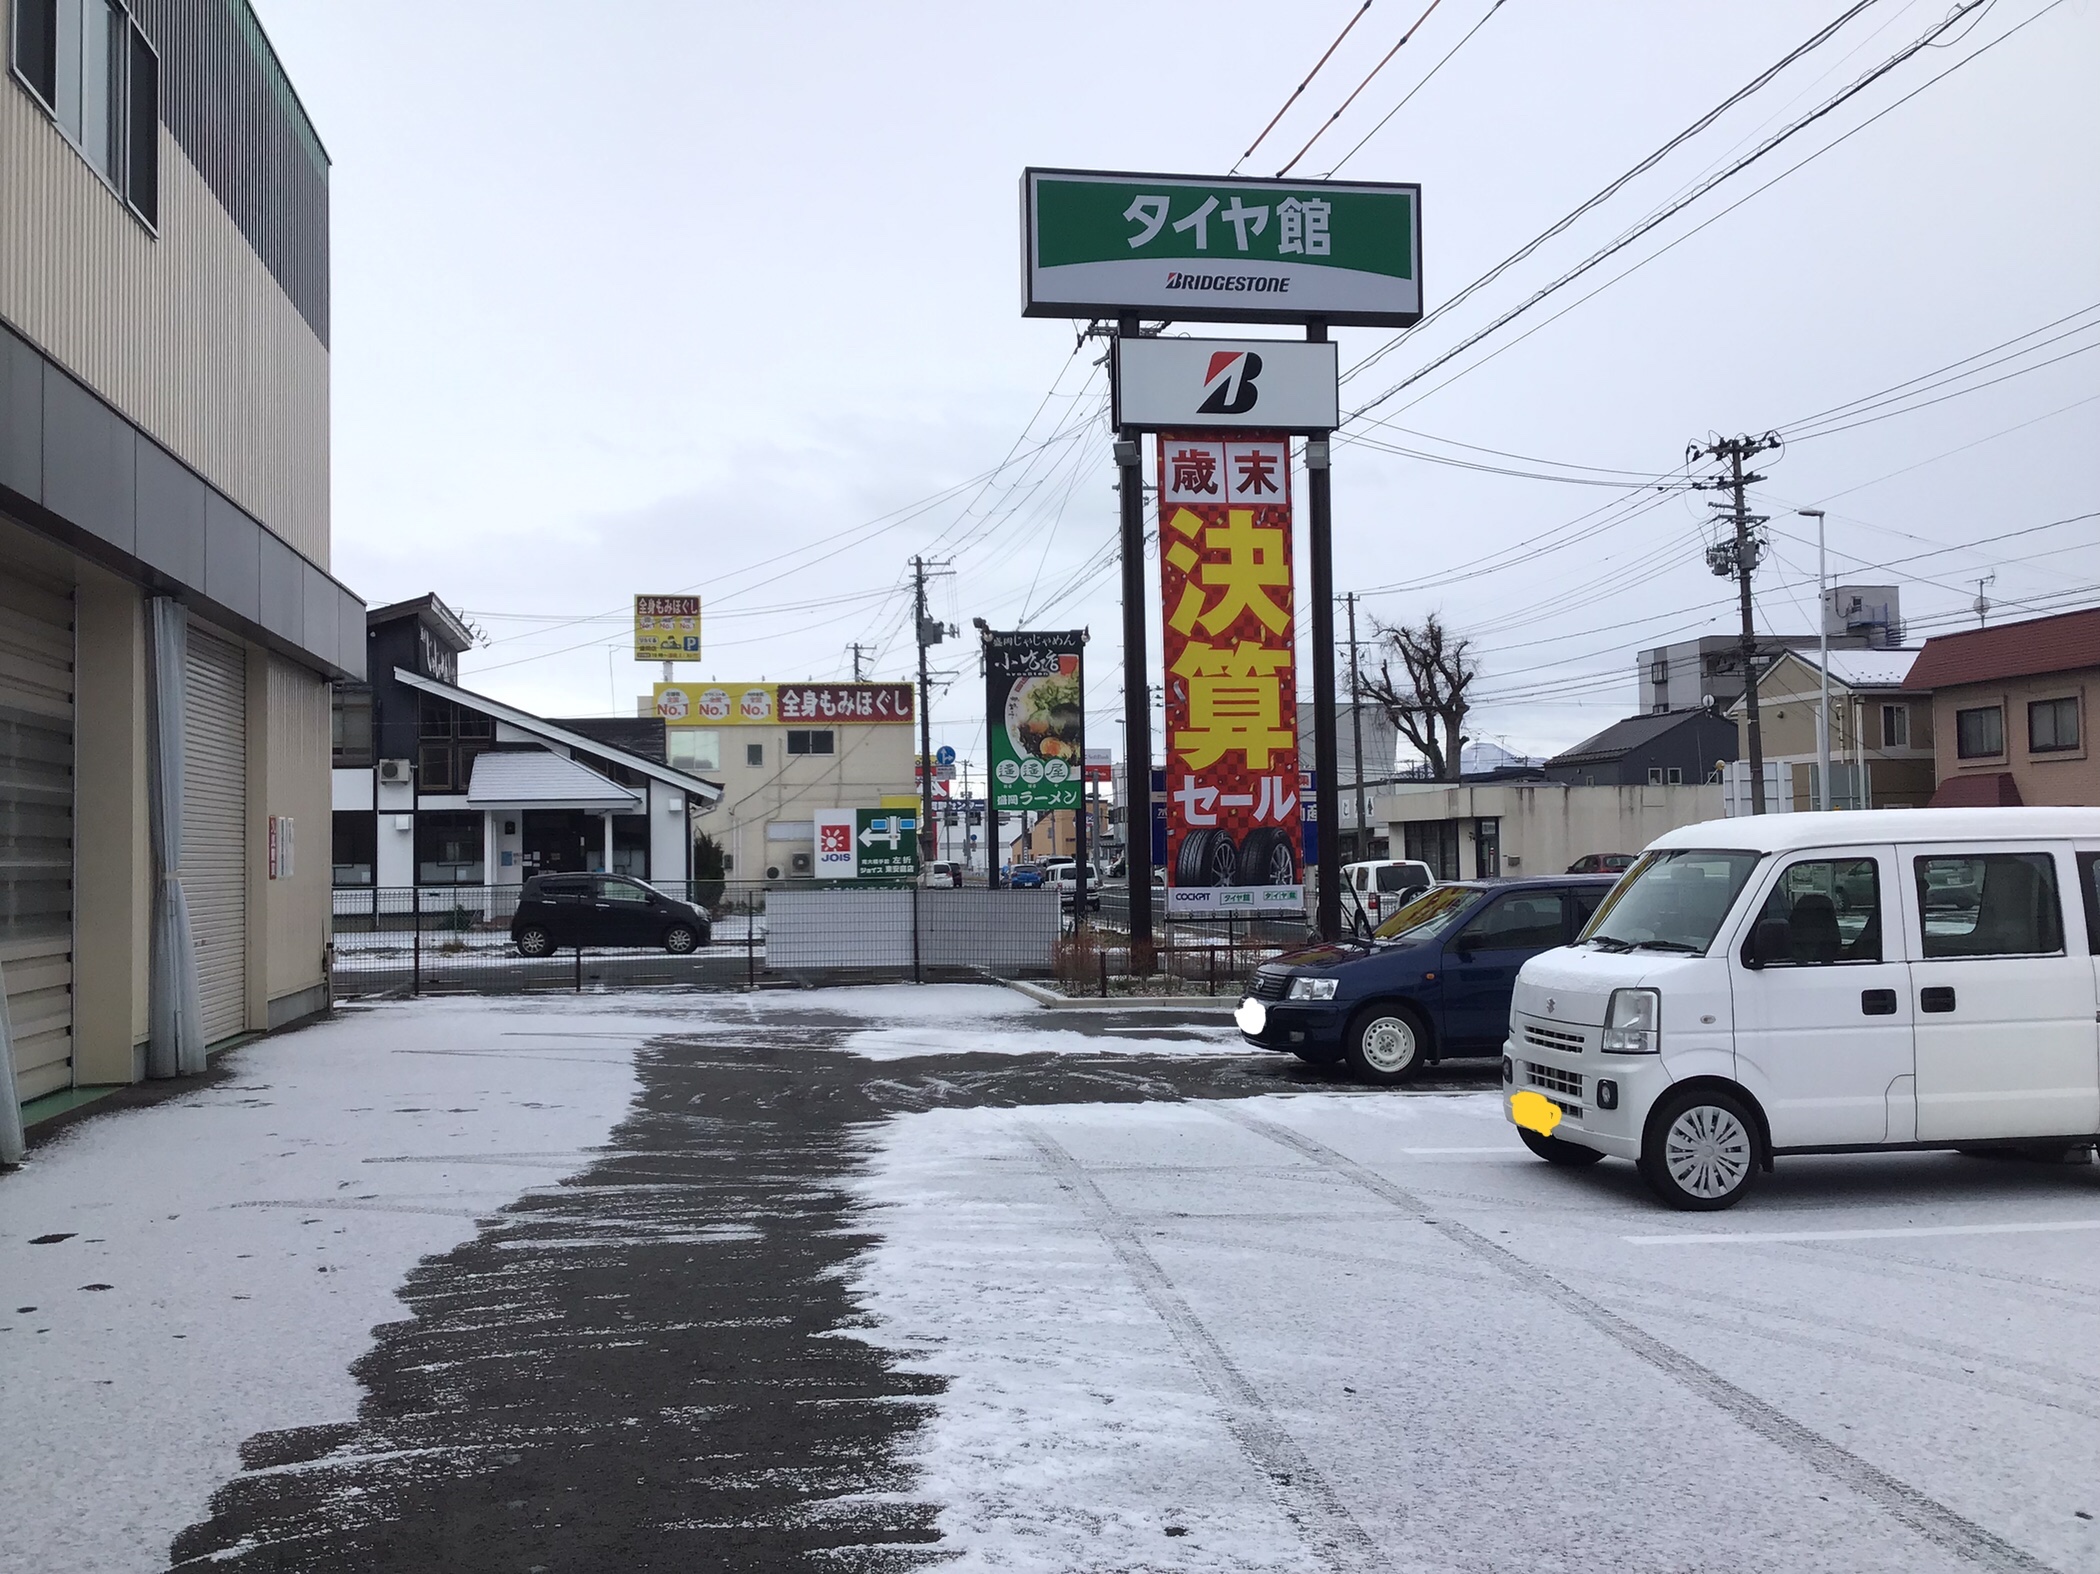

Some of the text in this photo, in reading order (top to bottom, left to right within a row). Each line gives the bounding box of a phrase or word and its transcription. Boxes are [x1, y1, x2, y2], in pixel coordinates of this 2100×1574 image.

[1123, 194, 1332, 256] タイヤ館
[1165, 272, 1291, 293] BRIDGESTONE
[1172, 449, 1279, 495] 歳末
[639, 598, 698, 614] 全身もみほぐし
[993, 634, 1076, 647] 盛岡じゃじゃめん
[1165, 507, 1294, 771] 決算
[657, 704, 689, 715] No.1
[699, 704, 730, 715] No.1
[741, 704, 772, 715] No.1
[782, 689, 909, 717] 全身もみほぐし
[997, 790, 1077, 806] 盛岡ラーメン
[1174, 775, 1297, 826] セール
[821, 854, 851, 862] JOIS
[892, 856, 911, 864] 左折
[1176, 893, 1210, 901] COCKPIT
[1224, 894, 1251, 902] タイヤ館
